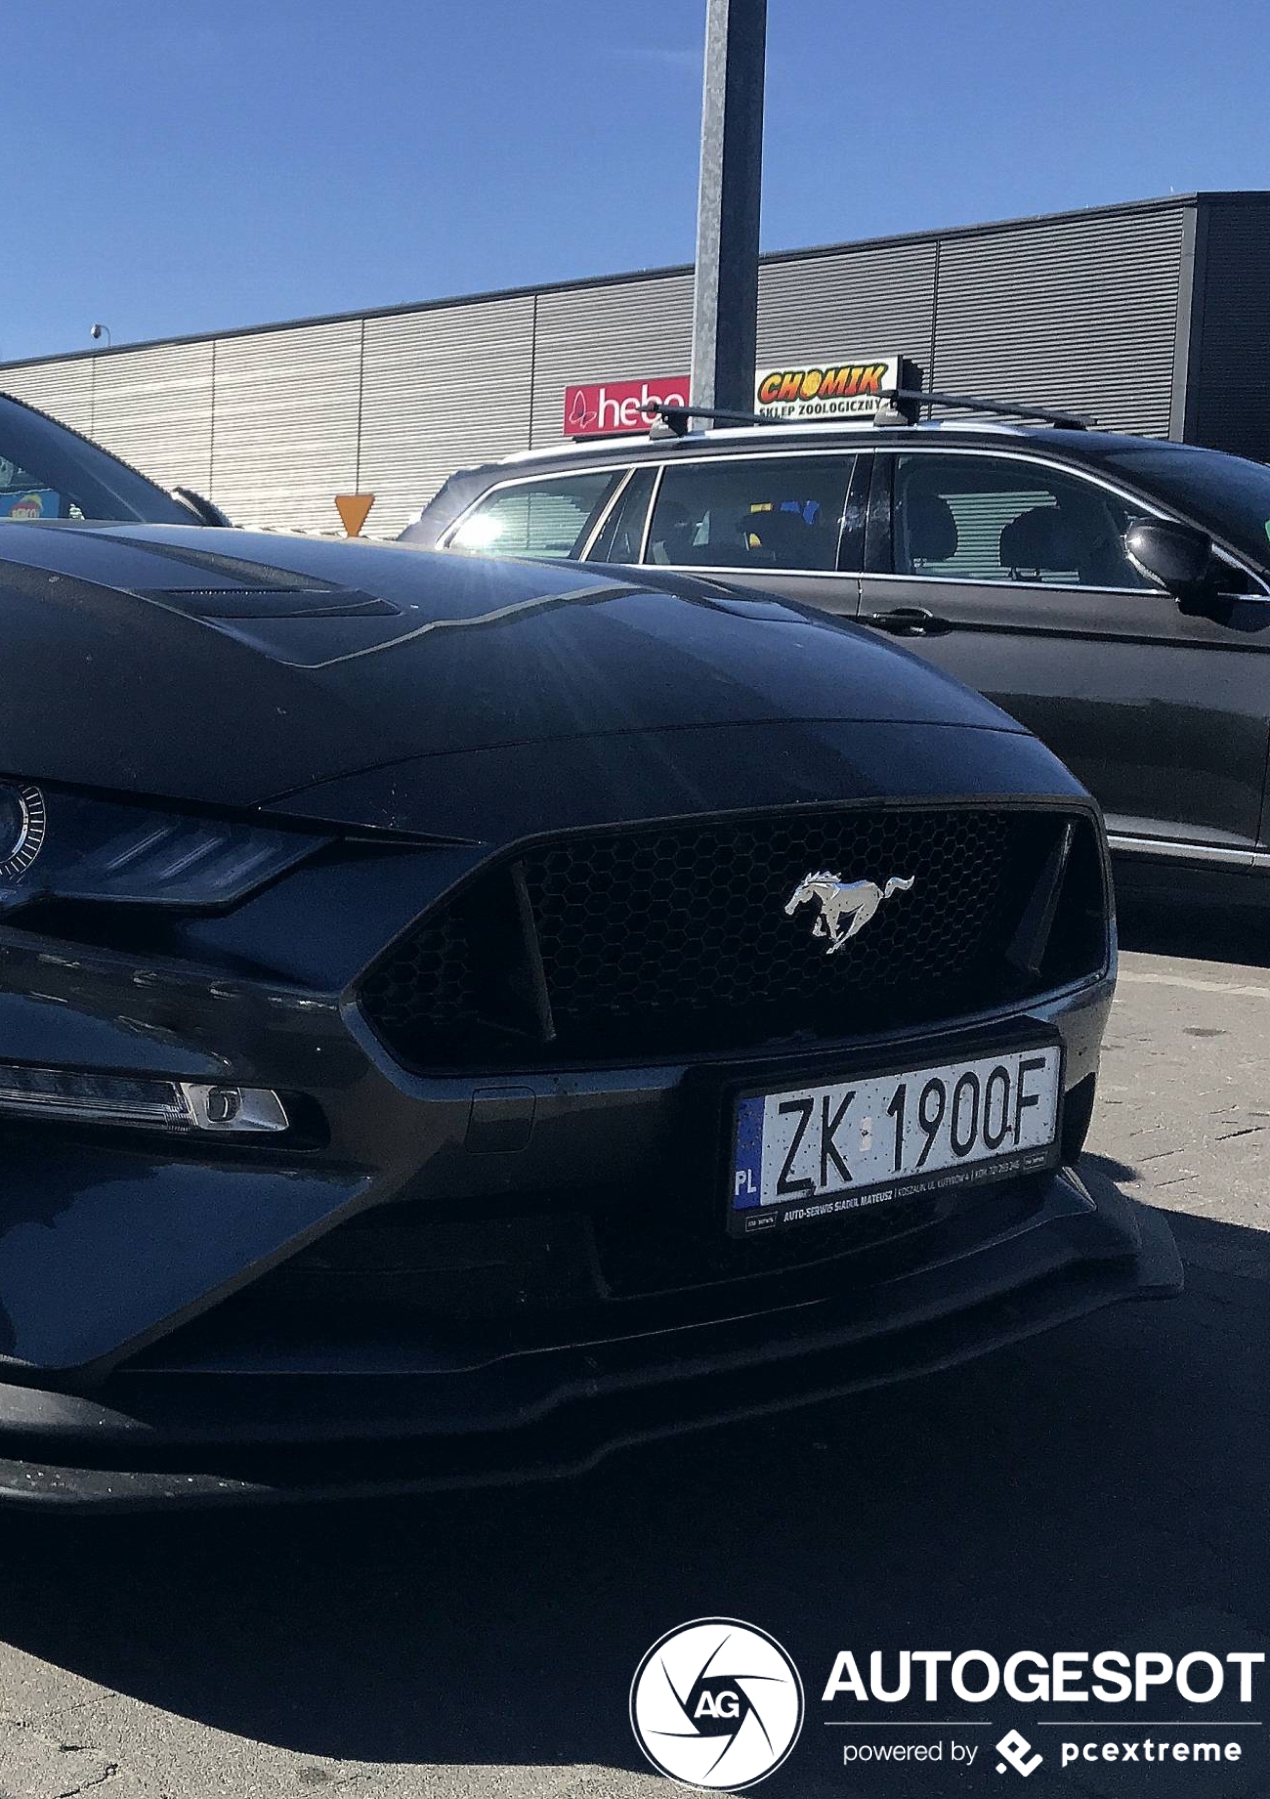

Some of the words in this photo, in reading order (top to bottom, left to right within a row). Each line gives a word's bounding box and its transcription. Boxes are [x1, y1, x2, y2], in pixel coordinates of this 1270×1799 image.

[758, 363, 888, 404] CHOMIK
[759, 405, 796, 419] SKLEP
[797, 399, 881, 416] ZOOLOGICZNY
[777, 1090, 857, 1195] ZK
[886, 1056, 1046, 1173] 1900F
[734, 1169, 757, 1196] PL
